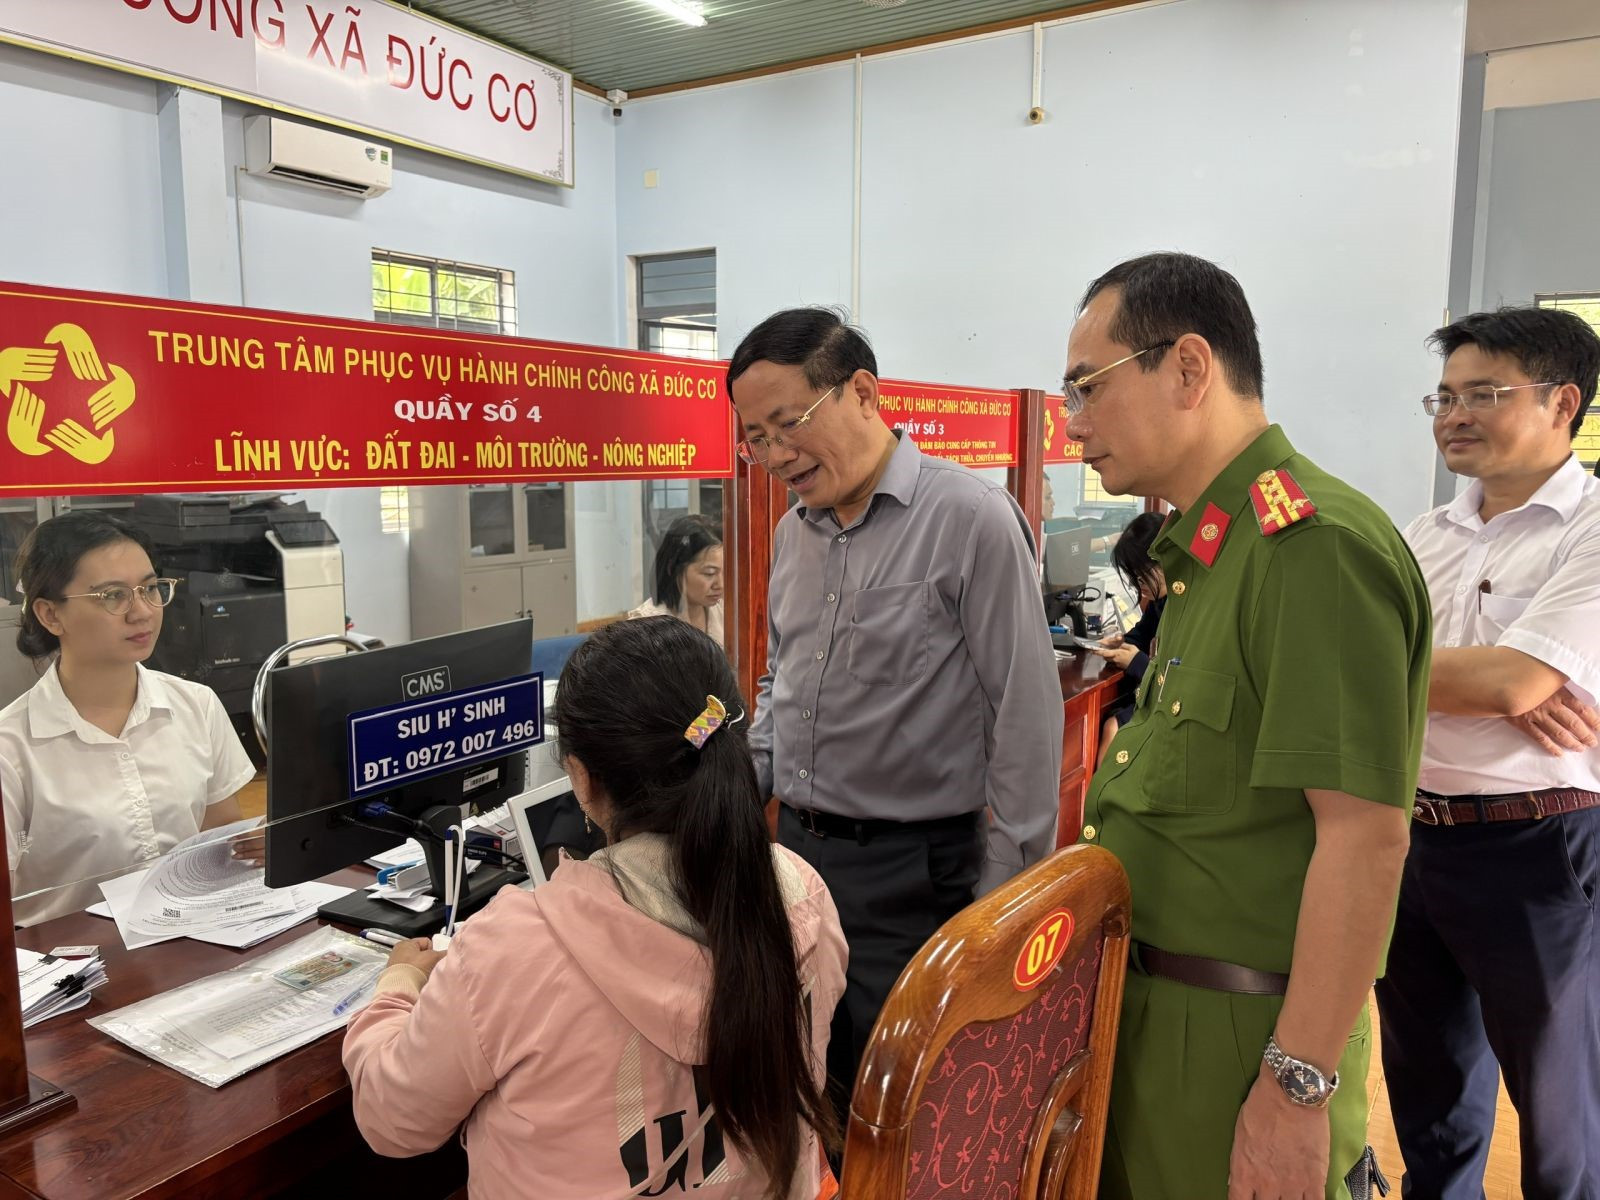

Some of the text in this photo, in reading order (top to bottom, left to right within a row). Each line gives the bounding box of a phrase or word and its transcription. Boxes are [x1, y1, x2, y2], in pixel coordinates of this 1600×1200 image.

[306, 5, 368, 75] XÃ
[386, 34, 473, 110] ĐỨC
[488, 72, 538, 131] CƠ
[148, 330, 717, 400] TRUNG TÂM PHỤC VỤ HÀNH CHÍNH CÔNG XÃ ĐỨC CƠ
[394, 393, 543, 423] QUẦY SỐ 4
[879, 394, 1011, 416] PHỤC VỤ HÀNH CHÍNH CÔNG XÃ ĐỨC CƠ
[923, 419, 936, 435] SỐ
[938, 424, 945, 435] 3
[215, 431, 281, 472] LĨNH
[290, 434, 350, 477] VỰC:
[366, 430, 412, 470] ĐẤT
[419, 440, 456, 469] ĐAI
[476, 435, 513, 469] MÔI
[518, 435, 588, 468] TRƯỜNG
[603, 436, 644, 467] NÔNG
[647, 438, 697, 470] NGHIỆP
[406, 672, 445, 697] CMS
[397, 714, 431, 739] SIU
[463, 696, 506, 722] SINH
[364, 719, 535, 782] ĐT: 0972 007 496
[1027, 918, 1063, 976] 07
